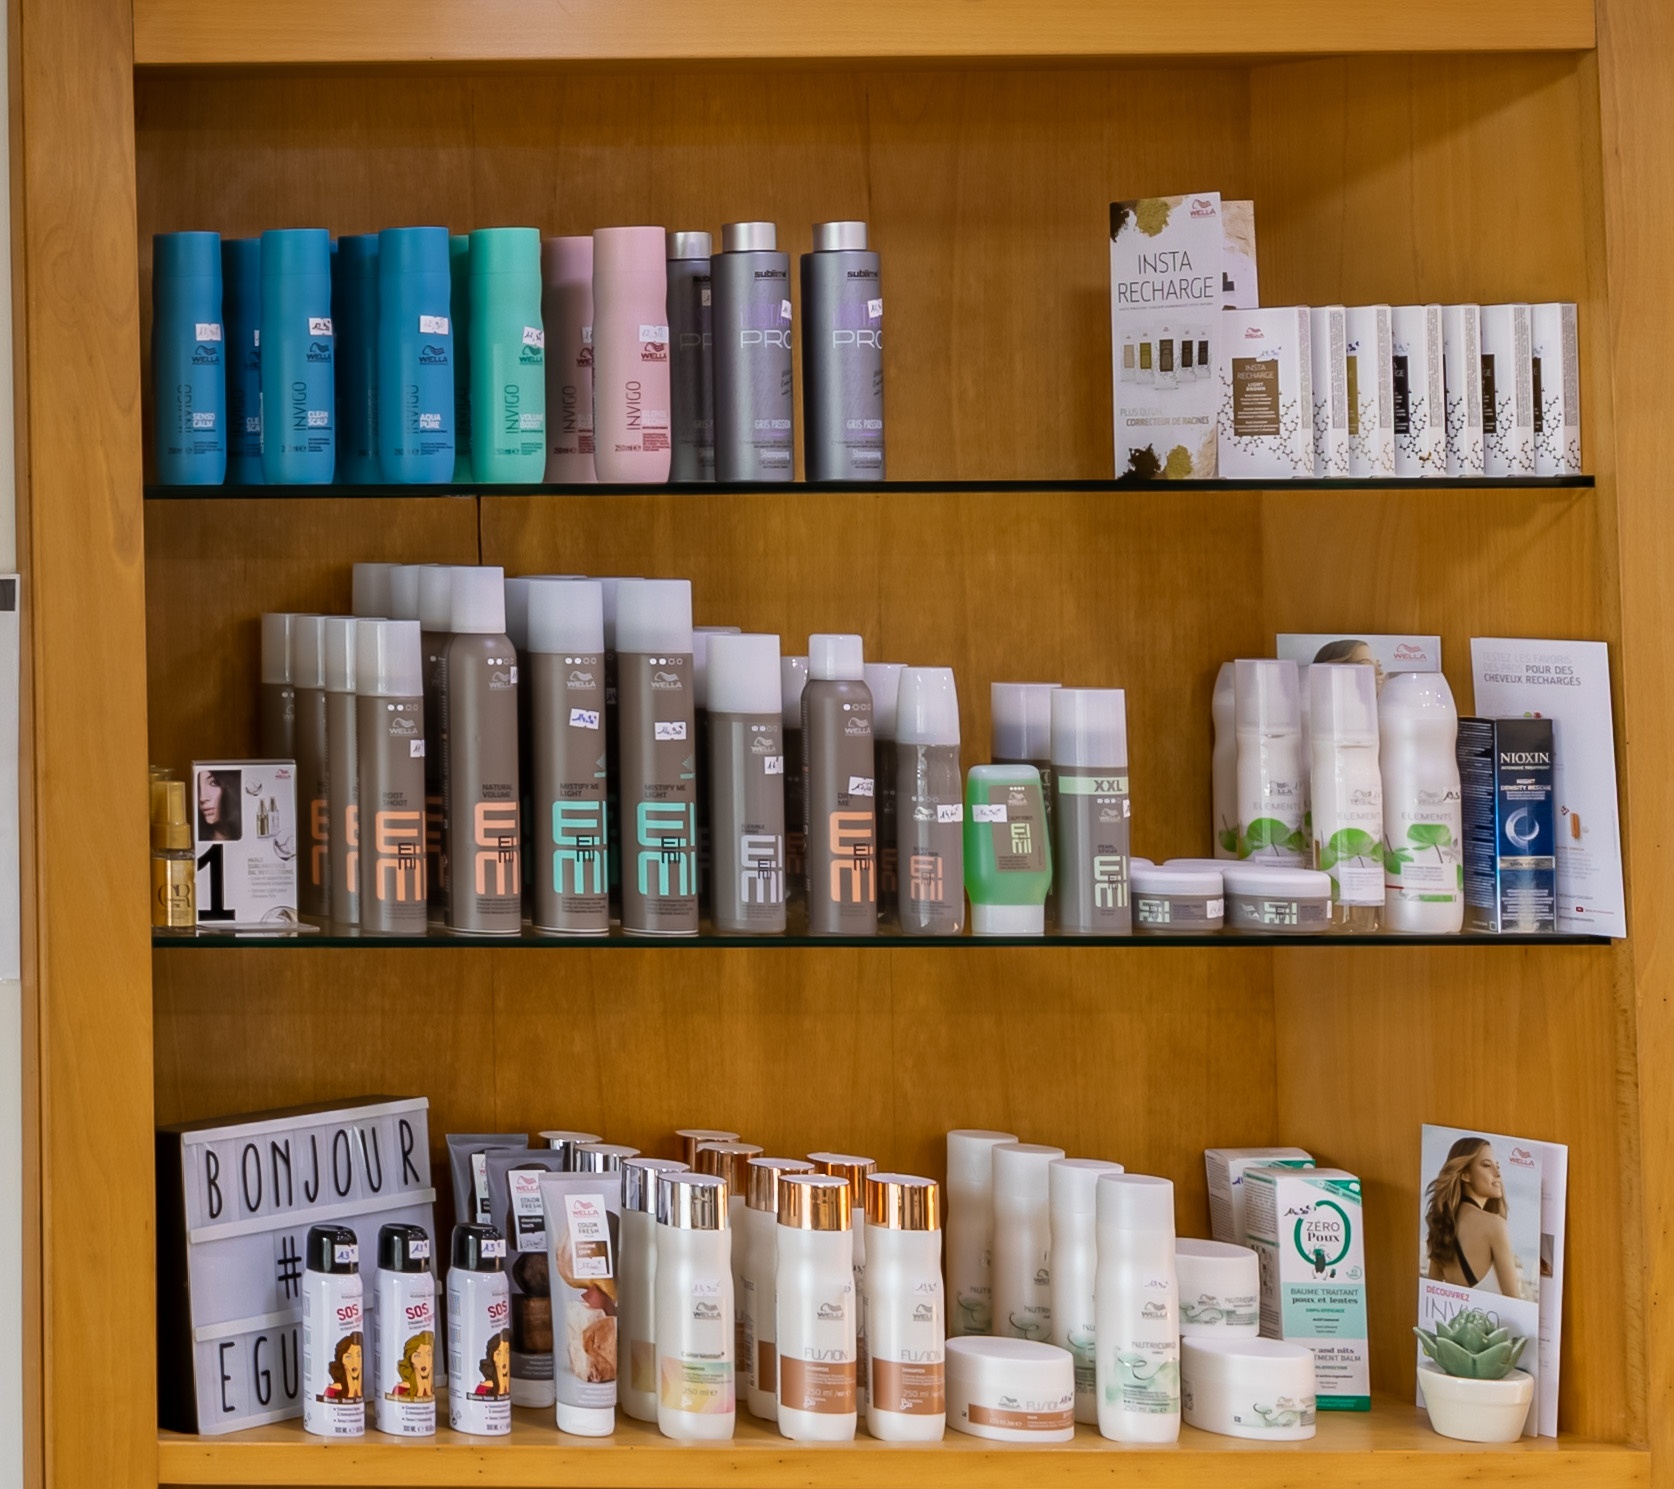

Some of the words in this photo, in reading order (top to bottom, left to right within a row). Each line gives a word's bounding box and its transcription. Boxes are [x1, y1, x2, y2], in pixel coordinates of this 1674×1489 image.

[1190, 208, 1216, 218] WELLA
[1138, 250, 1193, 275] INSTA
[1118, 276, 1215, 304] RECHARGE
[641, 352, 667, 360] WELLA
[1237, 371, 1275, 380] RECHARGE
[292, 381, 307, 431] INVIGO
[504, 384, 520, 434] INVIGO
[562, 385, 576, 434] INVIGO
[626, 380, 641, 431] INVIGO
[420, 414, 442, 422] AQUA
[1126, 417, 1170, 427] CORRECTEUR
[1182, 416, 1209, 426] RACINES
[193, 420, 214, 428] CALM
[420, 421, 440, 429] PURE
[754, 419, 771, 429] GRIS
[846, 419, 862, 429] GRIS
[1394, 652, 1426, 661] WELLA
[1525, 664, 1551, 674] POUR
[1555, 665, 1574, 675] DES
[1484, 673, 1523, 684] CHEVEUX
[1525, 674, 1582, 686] RECHARGÉS
[567, 681, 596, 689] WELLA
[651, 681, 682, 689] WELLA
[845, 727, 872, 735] WELLA
[1500, 752, 1551, 764] NIOXIN
[644, 784, 675, 792] MISTIFY
[1093, 780, 1123, 793] XXL
[482, 791, 511, 799] VOLUME
[560, 790, 582, 798] LIGHT
[644, 791, 667, 799] LIGHT
[837, 799, 850, 807] ME
[1401, 813, 1453, 821] ELEMENTS
[197, 844, 236, 921] 1
[1509, 1157, 1535, 1166] WELLA
[205, 1118, 421, 1219] BONJOUR
[572, 1209, 599, 1217] WELLA
[1306, 1219, 1341, 1232] ZÉRO
[1307, 1231, 1341, 1243] Poux
[1290, 1288, 1320, 1296] BAUME
[1322, 1288, 1360, 1297] TRAITANT
[1426, 1286, 1471, 1303] DÉCOUVREZ
[1292, 1297, 1316, 1305] poux
[1317, 1296, 1328, 1305] et
[1329, 1297, 1359, 1305] lentes
[336, 1303, 360, 1322] SOS
[405, 1302, 430, 1320] SOS
[487, 1300, 509, 1320] SOS
[693, 1311, 722, 1319] WELLA
[1337, 1347, 1355, 1355] nits
[1341, 1355, 1362, 1363] BALM
